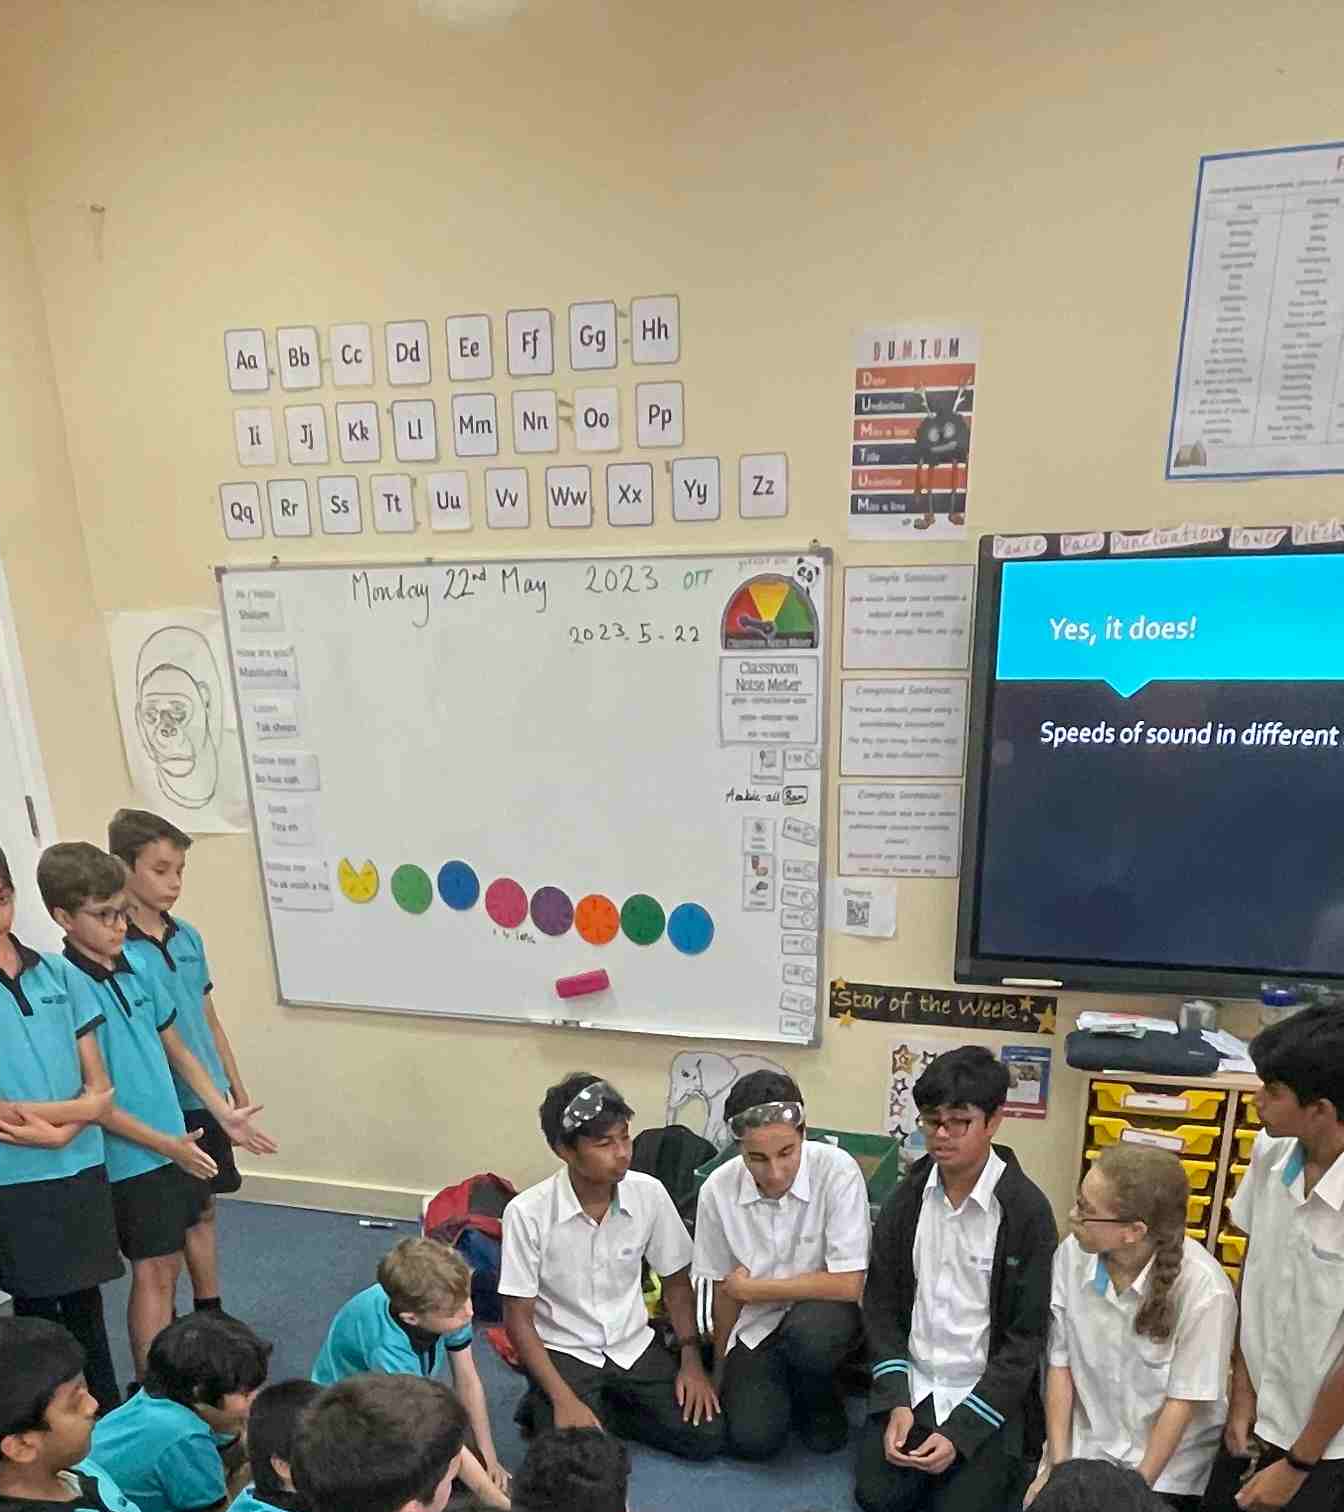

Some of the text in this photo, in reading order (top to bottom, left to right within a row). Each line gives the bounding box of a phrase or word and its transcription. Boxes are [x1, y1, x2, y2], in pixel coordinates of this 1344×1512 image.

[236, 317, 669, 370] Aa Bb Cc Dd Ee Ff Gg Hh
[248, 403, 672, 450] Ii Jj Kk Ll Mm Nn Oo Pp
[230, 475, 775, 525] Qq Rr Ss Tt Uu Vv Ww Xx Yy Zz
[1232, 529, 1286, 547] Power
[1293, 521, 1344, 543] Pitch
[352, 570, 430, 628] Monday
[501, 568, 551, 613] May
[585, 565, 659, 593] 2023
[1050, 616, 1198, 645] Yes, it does!
[1040, 721, 1115, 747] Speeds
[1120, 721, 1146, 744] of
[1146, 721, 1211, 745] sound
[1216, 723, 1236, 745] in
[1241, 722, 1340, 747] different
[833, 991, 881, 1010] Star
[889, 993, 912, 1018] of
[920, 996, 952, 1015] the
